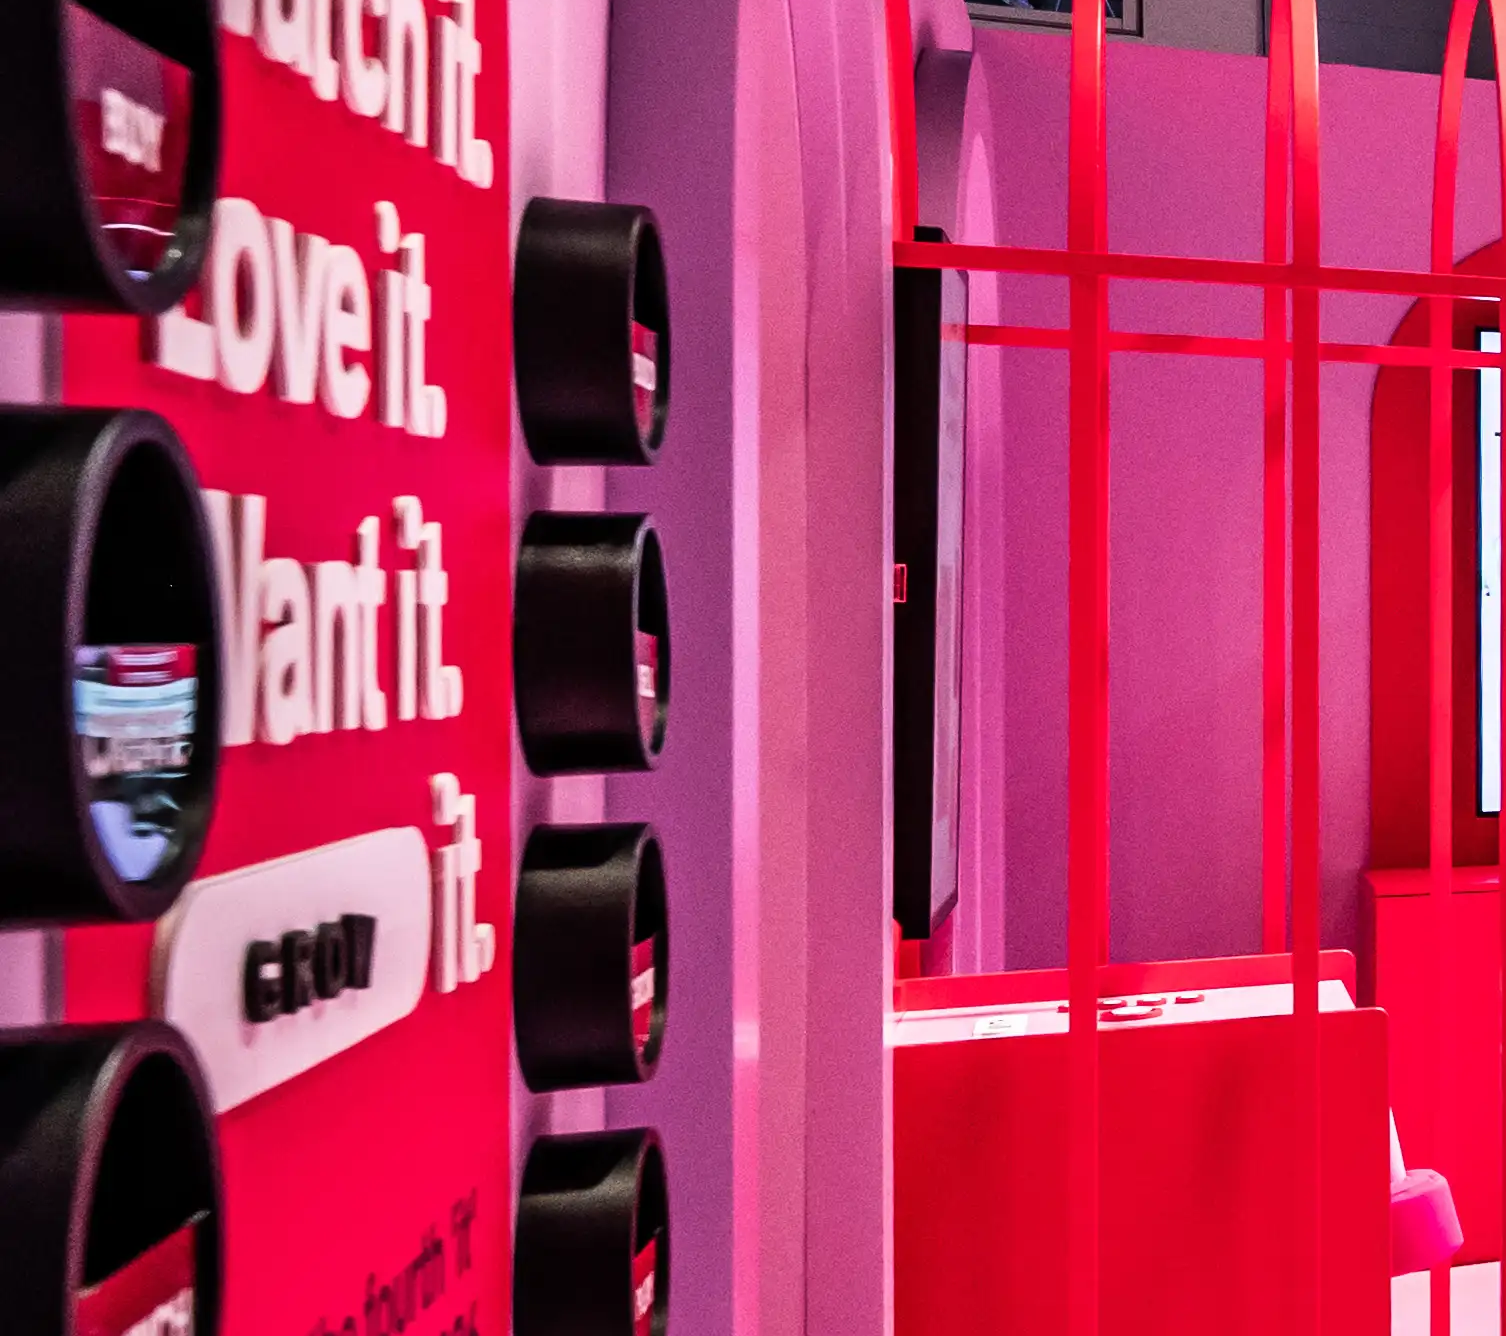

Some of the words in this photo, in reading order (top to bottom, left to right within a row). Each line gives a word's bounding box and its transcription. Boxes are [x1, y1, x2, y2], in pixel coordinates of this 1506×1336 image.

[374, 200, 448, 439] it.
[394, 495, 464, 721] it.
[430, 771, 496, 994] it.
